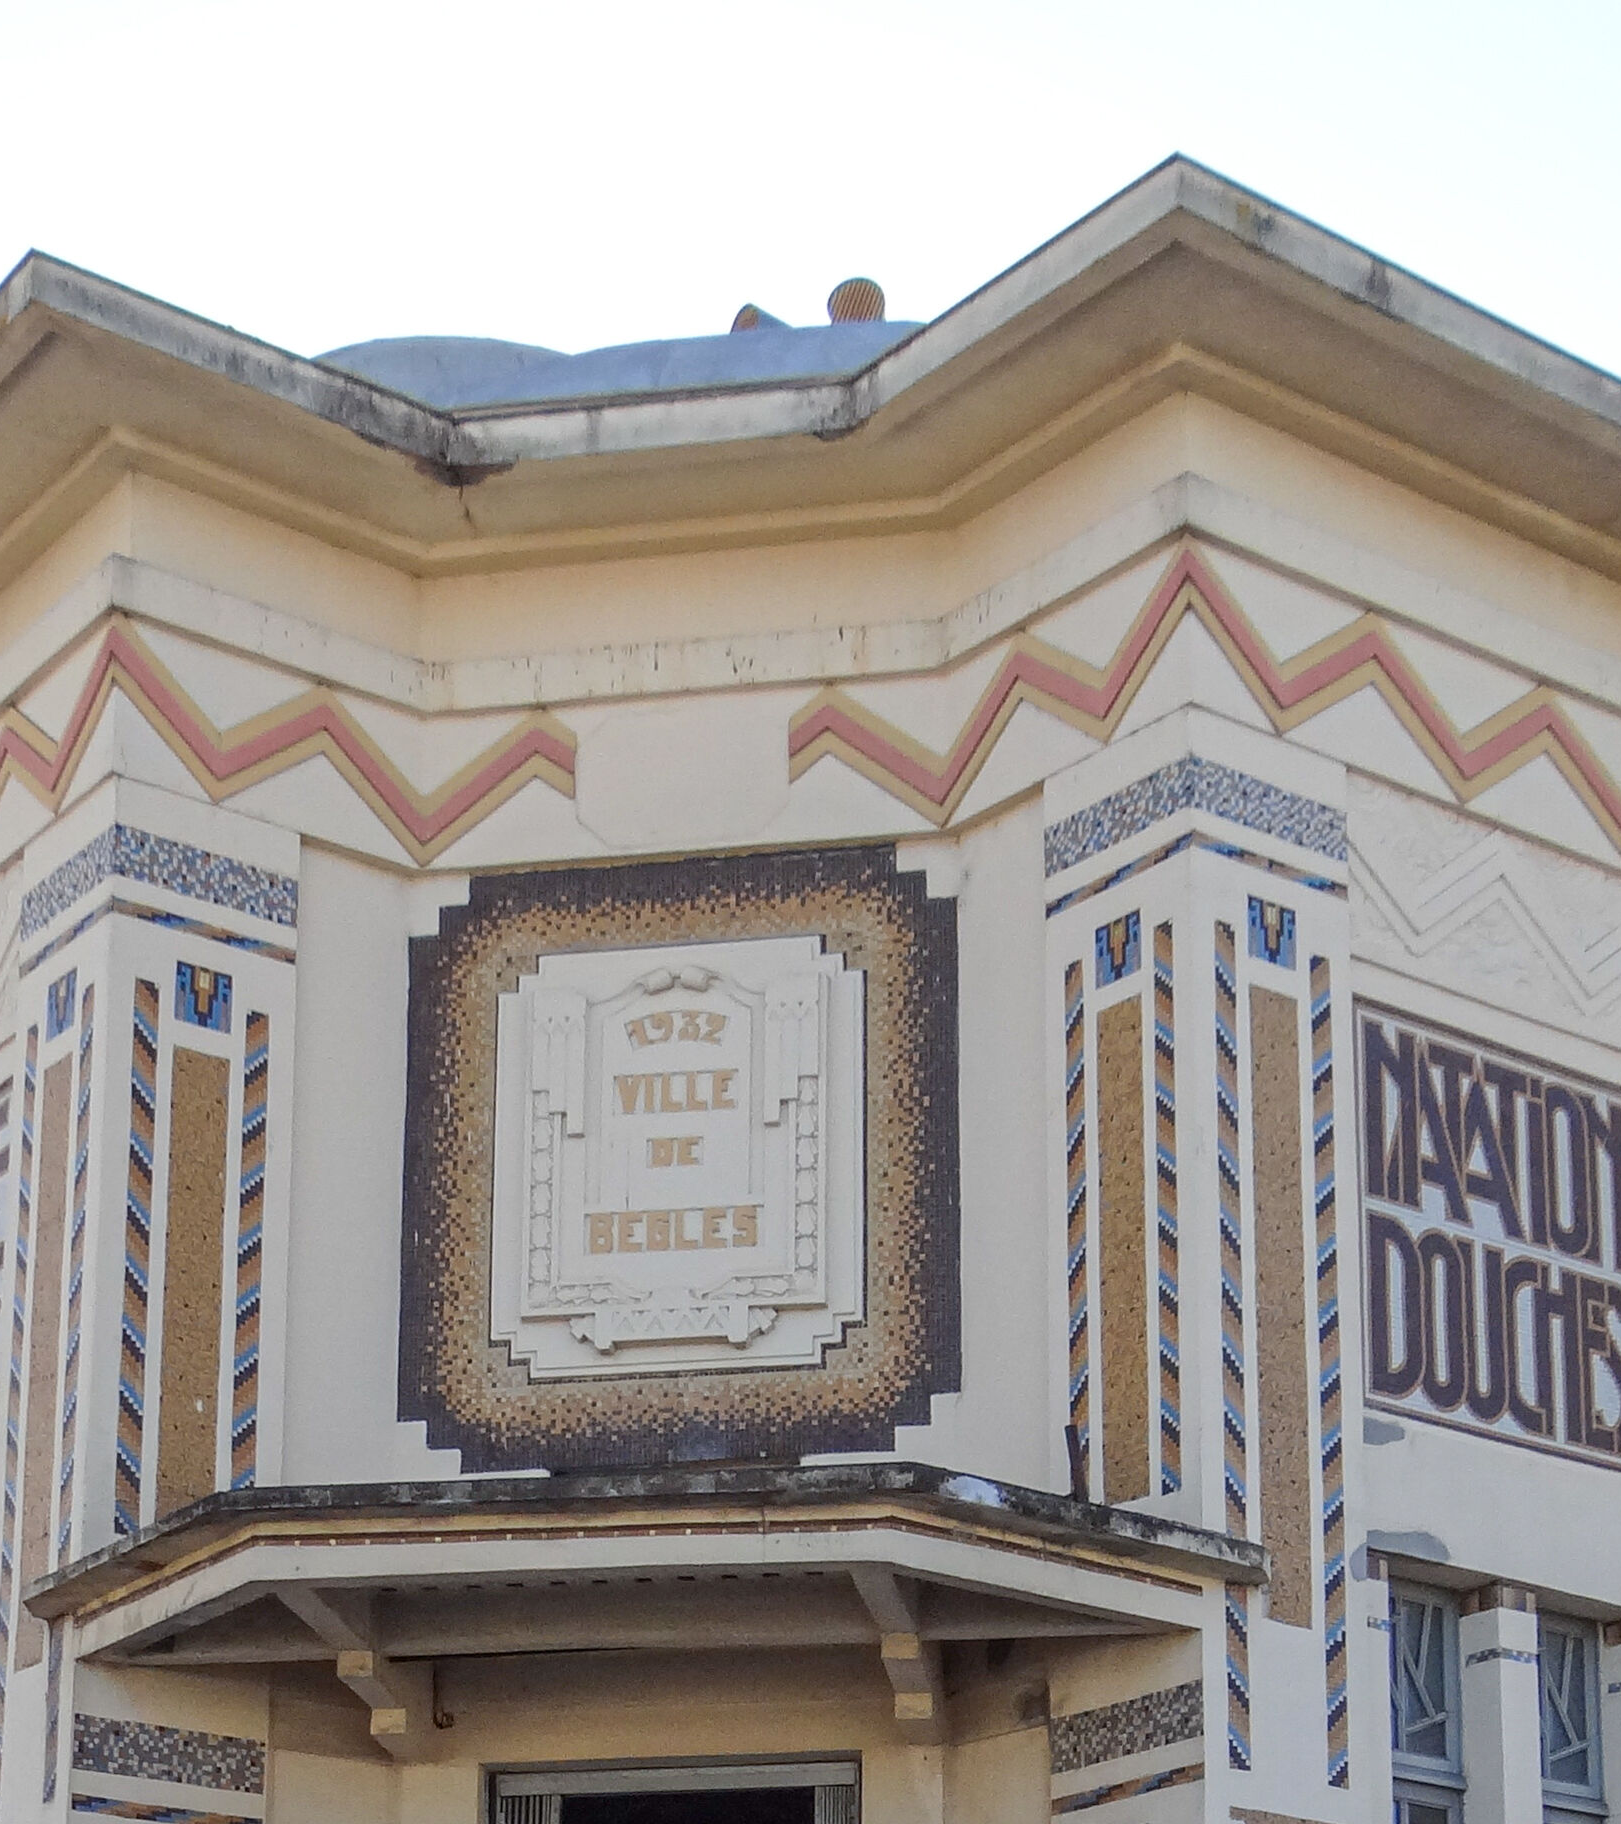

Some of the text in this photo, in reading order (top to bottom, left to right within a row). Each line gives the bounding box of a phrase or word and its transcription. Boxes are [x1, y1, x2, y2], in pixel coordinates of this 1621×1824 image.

[624, 1010, 730, 1049] 1932
[615, 1068, 739, 1115] VILLE
[648, 1136, 703, 1167] DE
